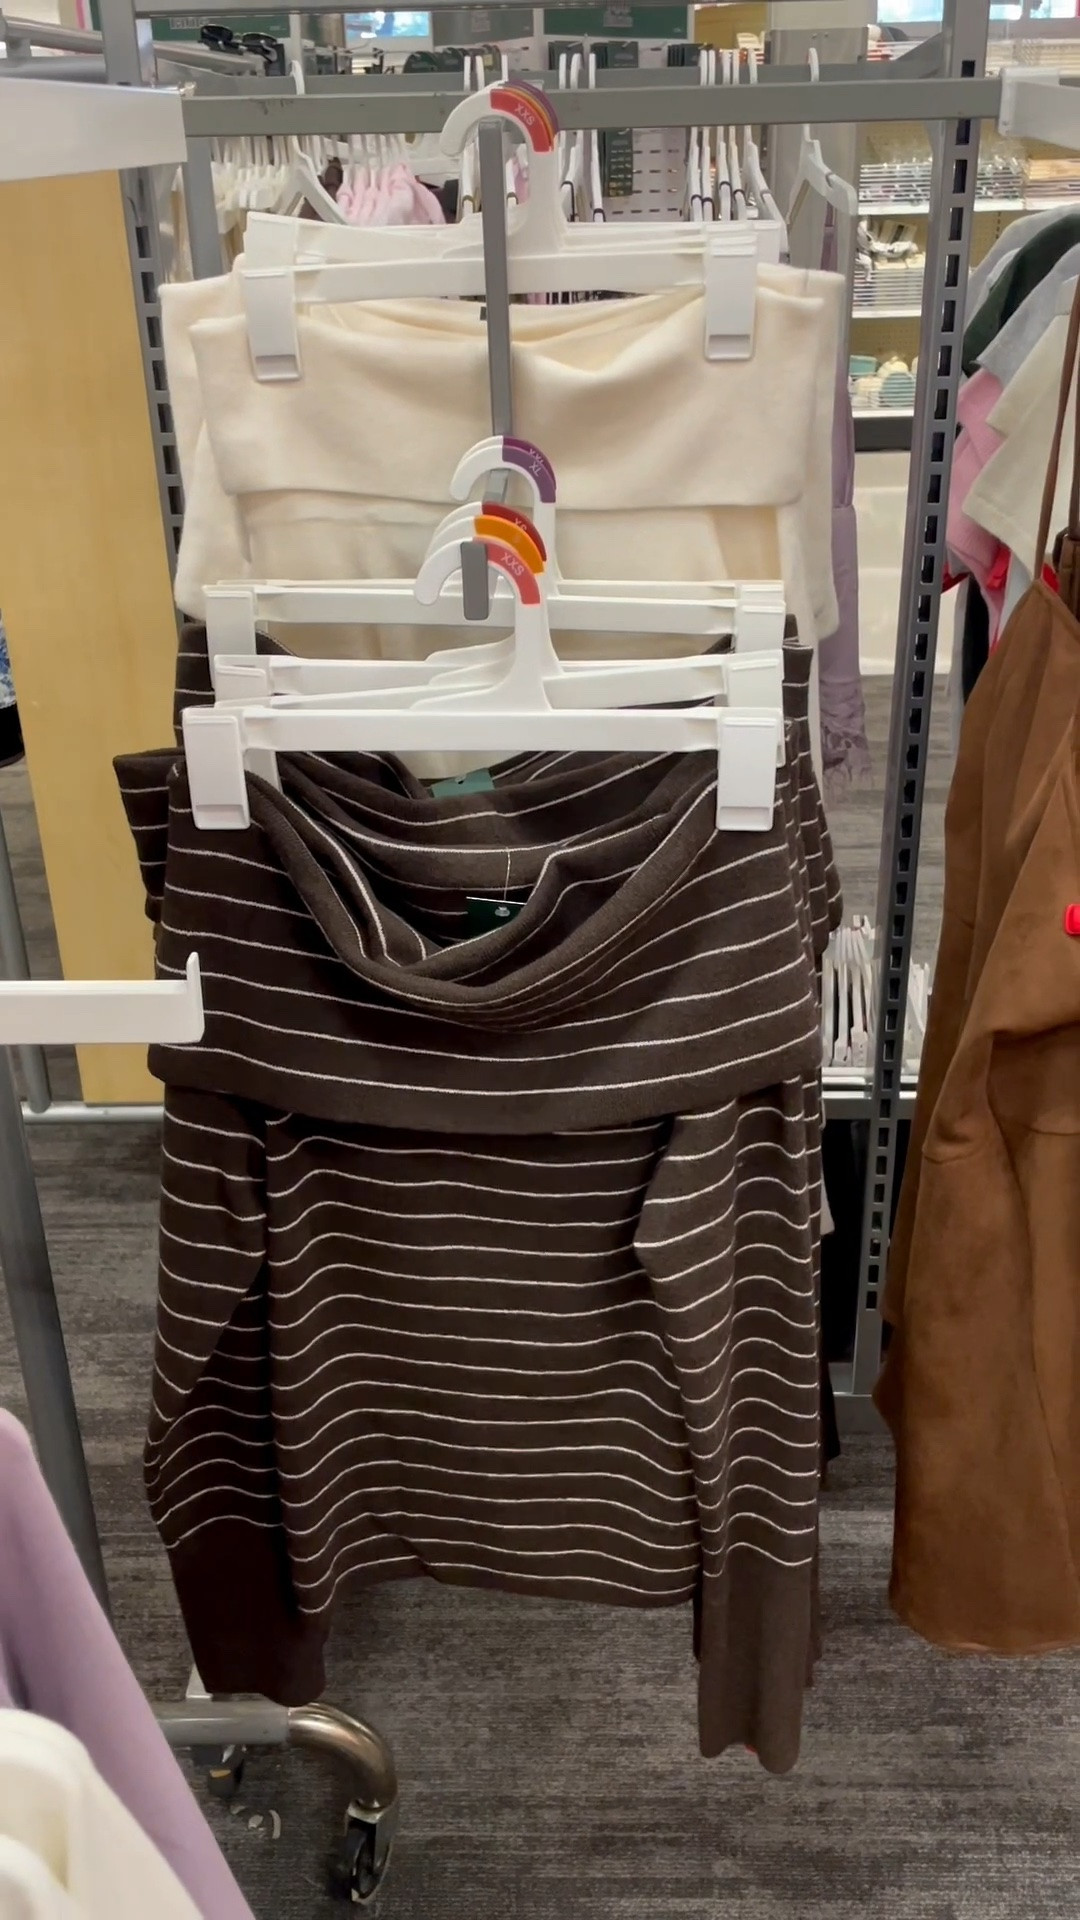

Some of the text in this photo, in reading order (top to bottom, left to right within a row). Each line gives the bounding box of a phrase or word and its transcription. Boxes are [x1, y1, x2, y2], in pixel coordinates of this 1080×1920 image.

[514, 103, 535, 126] XXS
[529, 461, 542, 477] XL
[500, 552, 524, 577] XXS
